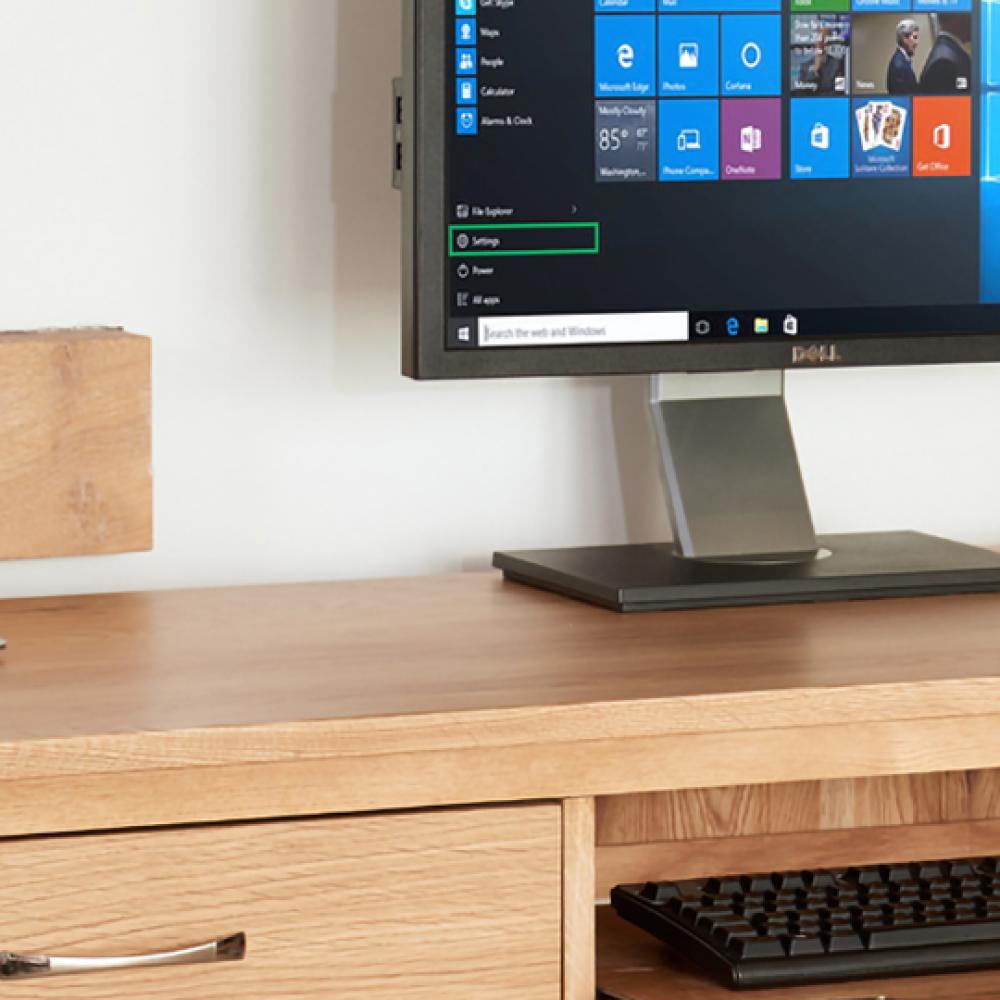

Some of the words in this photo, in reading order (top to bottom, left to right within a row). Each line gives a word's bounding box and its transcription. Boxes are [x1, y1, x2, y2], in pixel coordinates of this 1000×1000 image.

[480, 28, 500, 38] Maps
[480, 57, 504, 69] People
[599, 82, 631, 92] Microsoft
[632, 82, 649, 93] Edge
[662, 82, 686, 91] Photos
[725, 81, 752, 91] Cortana
[794, 81, 817, 91] Money
[855, 81, 875, 89] News
[480, 86, 515, 97] Calculator
[480, 116, 505, 127] Alarms
[513, 116, 533, 126] Clock
[662, 166, 684, 175] Phone
[726, 164, 755, 174] OneNote
[795, 164, 813, 173] Store
[917, 162, 929, 172] Get
[930, 161, 950, 171] Office
[472, 206, 484, 216] File
[485, 205, 513, 218] Explorer
[472, 235, 500, 248] Settings
[472, 265, 495, 275] Power
[483, 296, 501, 307] apps
[515, 327, 529, 338] the
[531, 326, 548, 338] web
[551, 326, 566, 337] and
[568, 325, 606, 337] Windows
[791, 343, 842, 363] DELL
